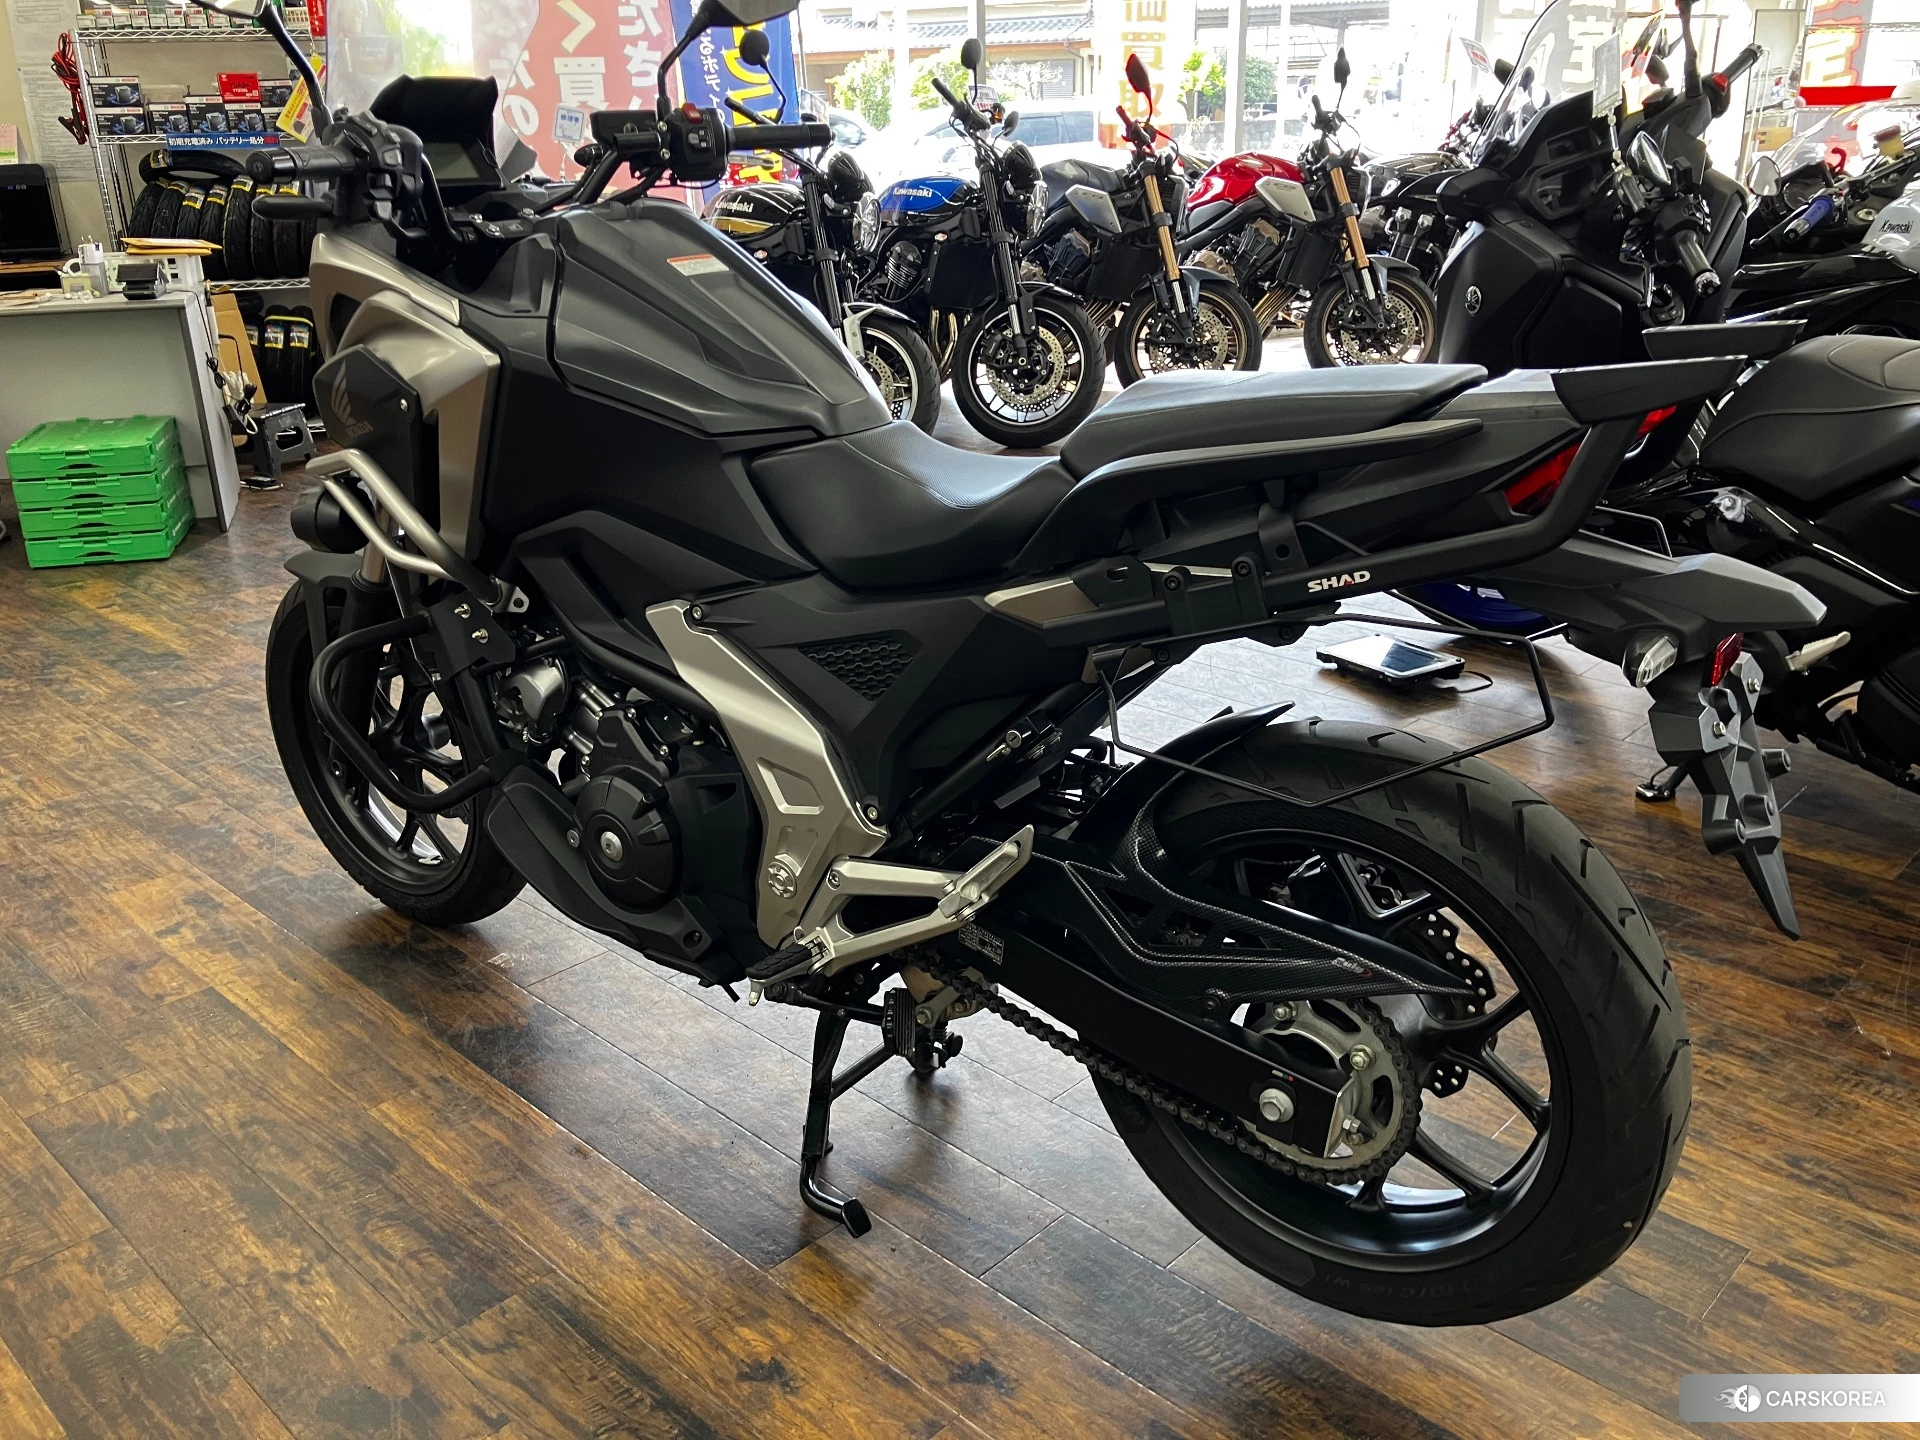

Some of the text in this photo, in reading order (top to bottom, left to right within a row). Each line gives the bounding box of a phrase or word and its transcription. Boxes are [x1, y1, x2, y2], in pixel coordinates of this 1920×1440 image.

[893, 186, 932, 198] Kawasaki
[715, 200, 754, 213] Kawasaki
[1878, 219, 1915, 234] Kawasaki
[1307, 570, 1371, 593] SHAD
